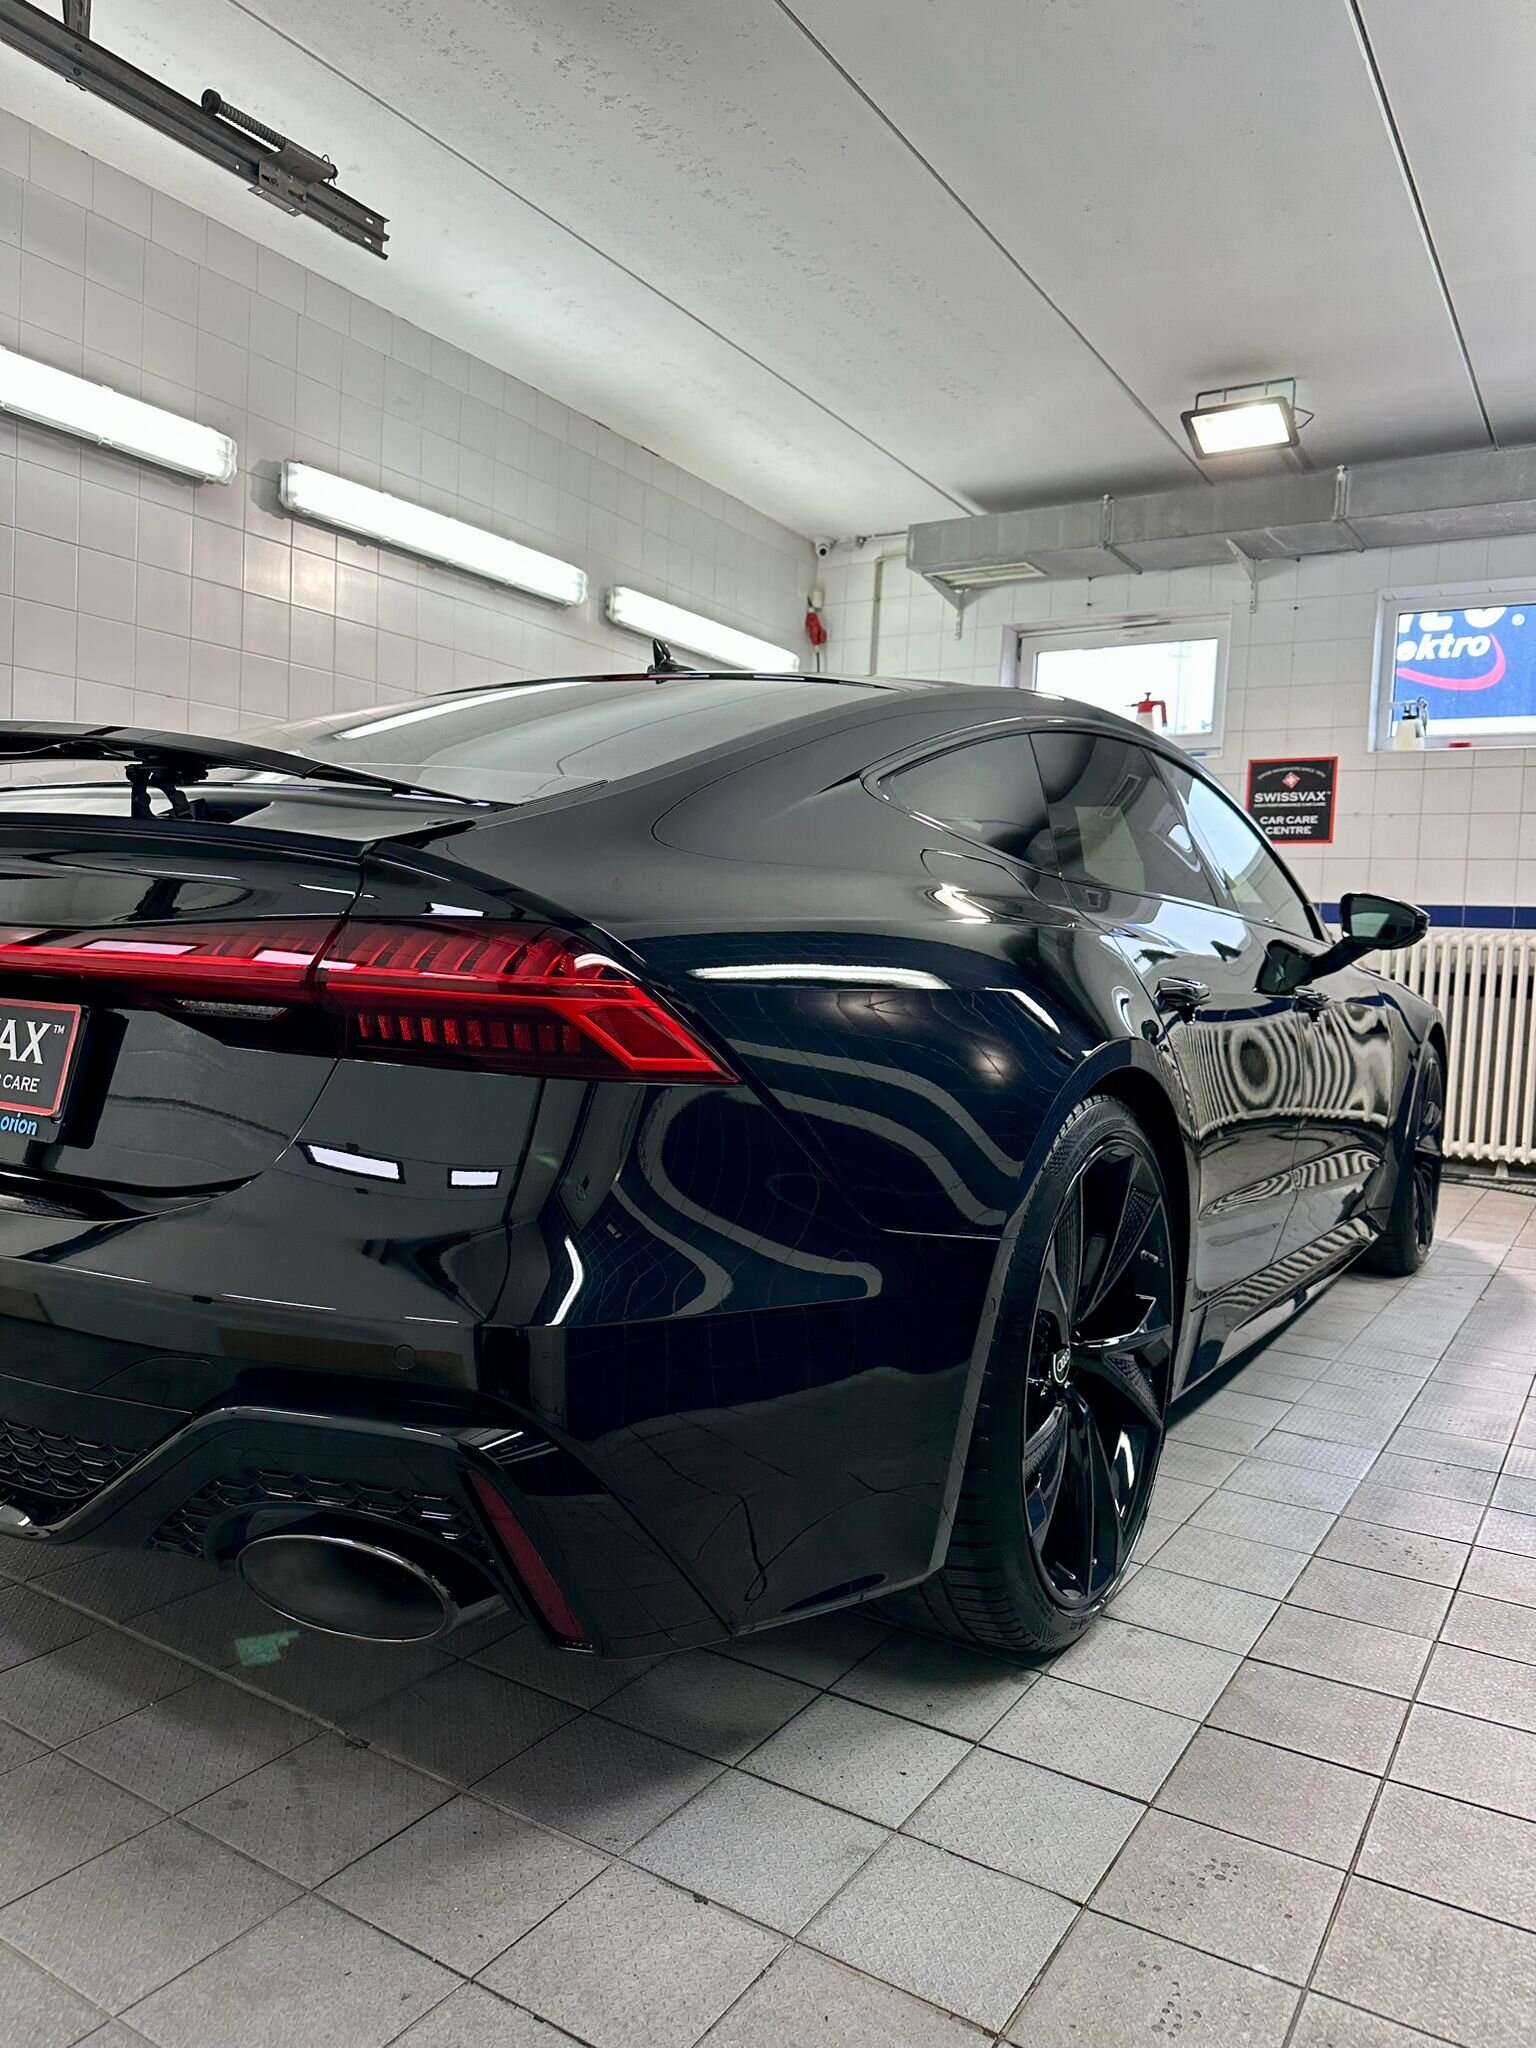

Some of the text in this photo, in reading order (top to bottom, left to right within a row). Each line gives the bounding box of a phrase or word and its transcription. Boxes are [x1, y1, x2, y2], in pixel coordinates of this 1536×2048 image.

[1254, 791, 1326, 802] SWISSVAX
[1260, 815, 1319, 825] CAR CARE
[1265, 826, 1312, 835] CENTRE
[0, 1018, 51, 1065] AX
[2, 1074, 41, 1093] CARE
[0, 1112, 38, 1136] orion
